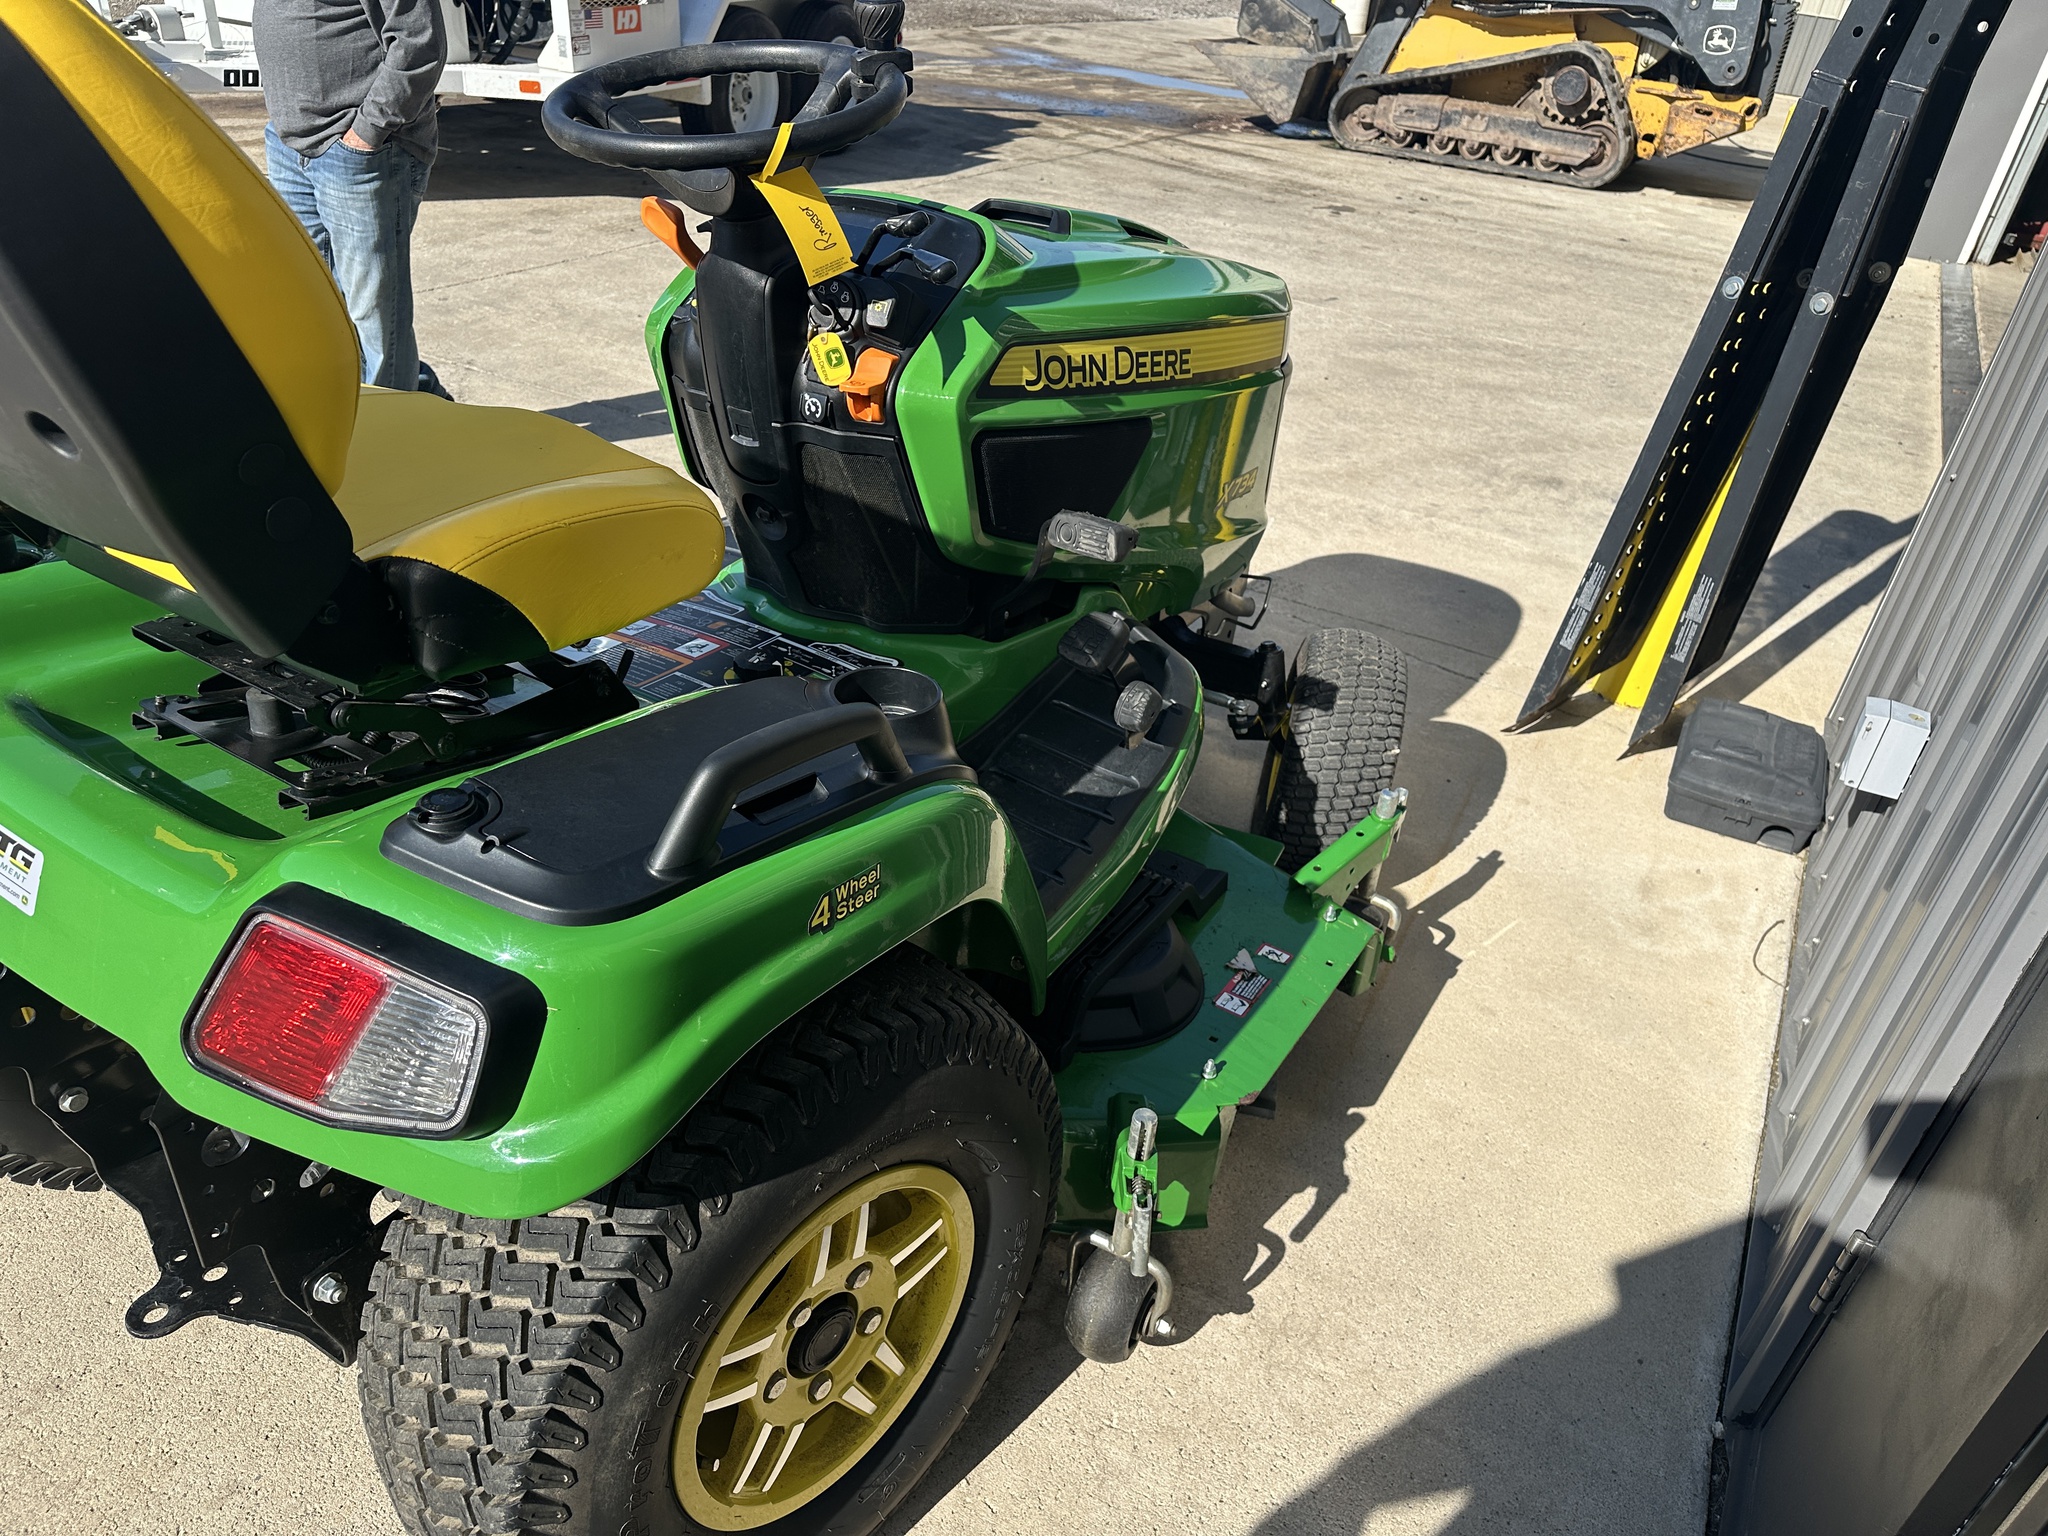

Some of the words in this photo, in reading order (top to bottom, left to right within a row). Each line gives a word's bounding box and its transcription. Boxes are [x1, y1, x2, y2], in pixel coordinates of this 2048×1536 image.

[616, 9, 639, 31] HD
[1024, 349, 1108, 391] JOHN
[1114, 346, 1192, 384] DEERE
[811, 895, 831, 928] 4
[836, 864, 880, 903] Wheel
[836, 884, 880, 919] Steer
